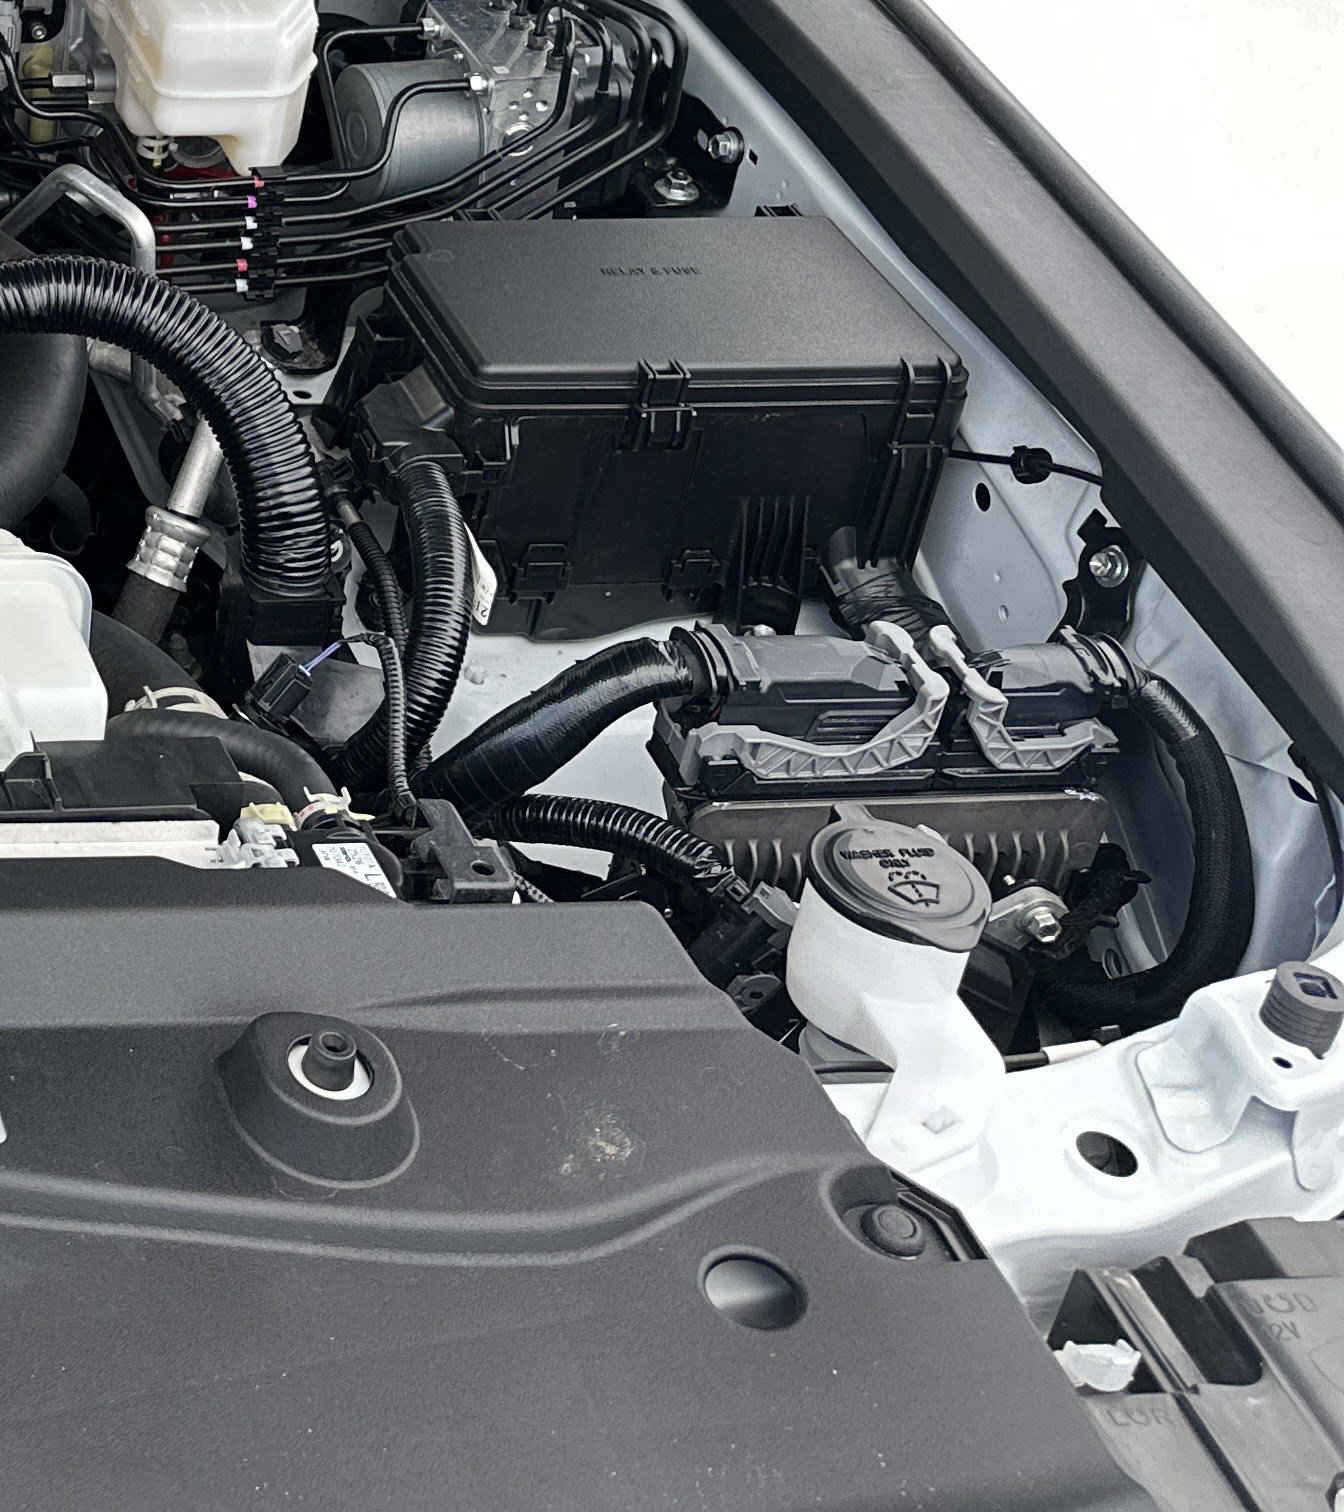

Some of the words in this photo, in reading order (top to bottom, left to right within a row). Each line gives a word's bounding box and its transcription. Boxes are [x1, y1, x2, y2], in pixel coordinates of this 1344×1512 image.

[599, 266, 646, 277] RELAY
[662, 266, 703, 276] FUSE
[839, 848, 895, 861] WASHER
[898, 847, 936, 858] FLUID
[878, 858, 911, 869] ONLY
